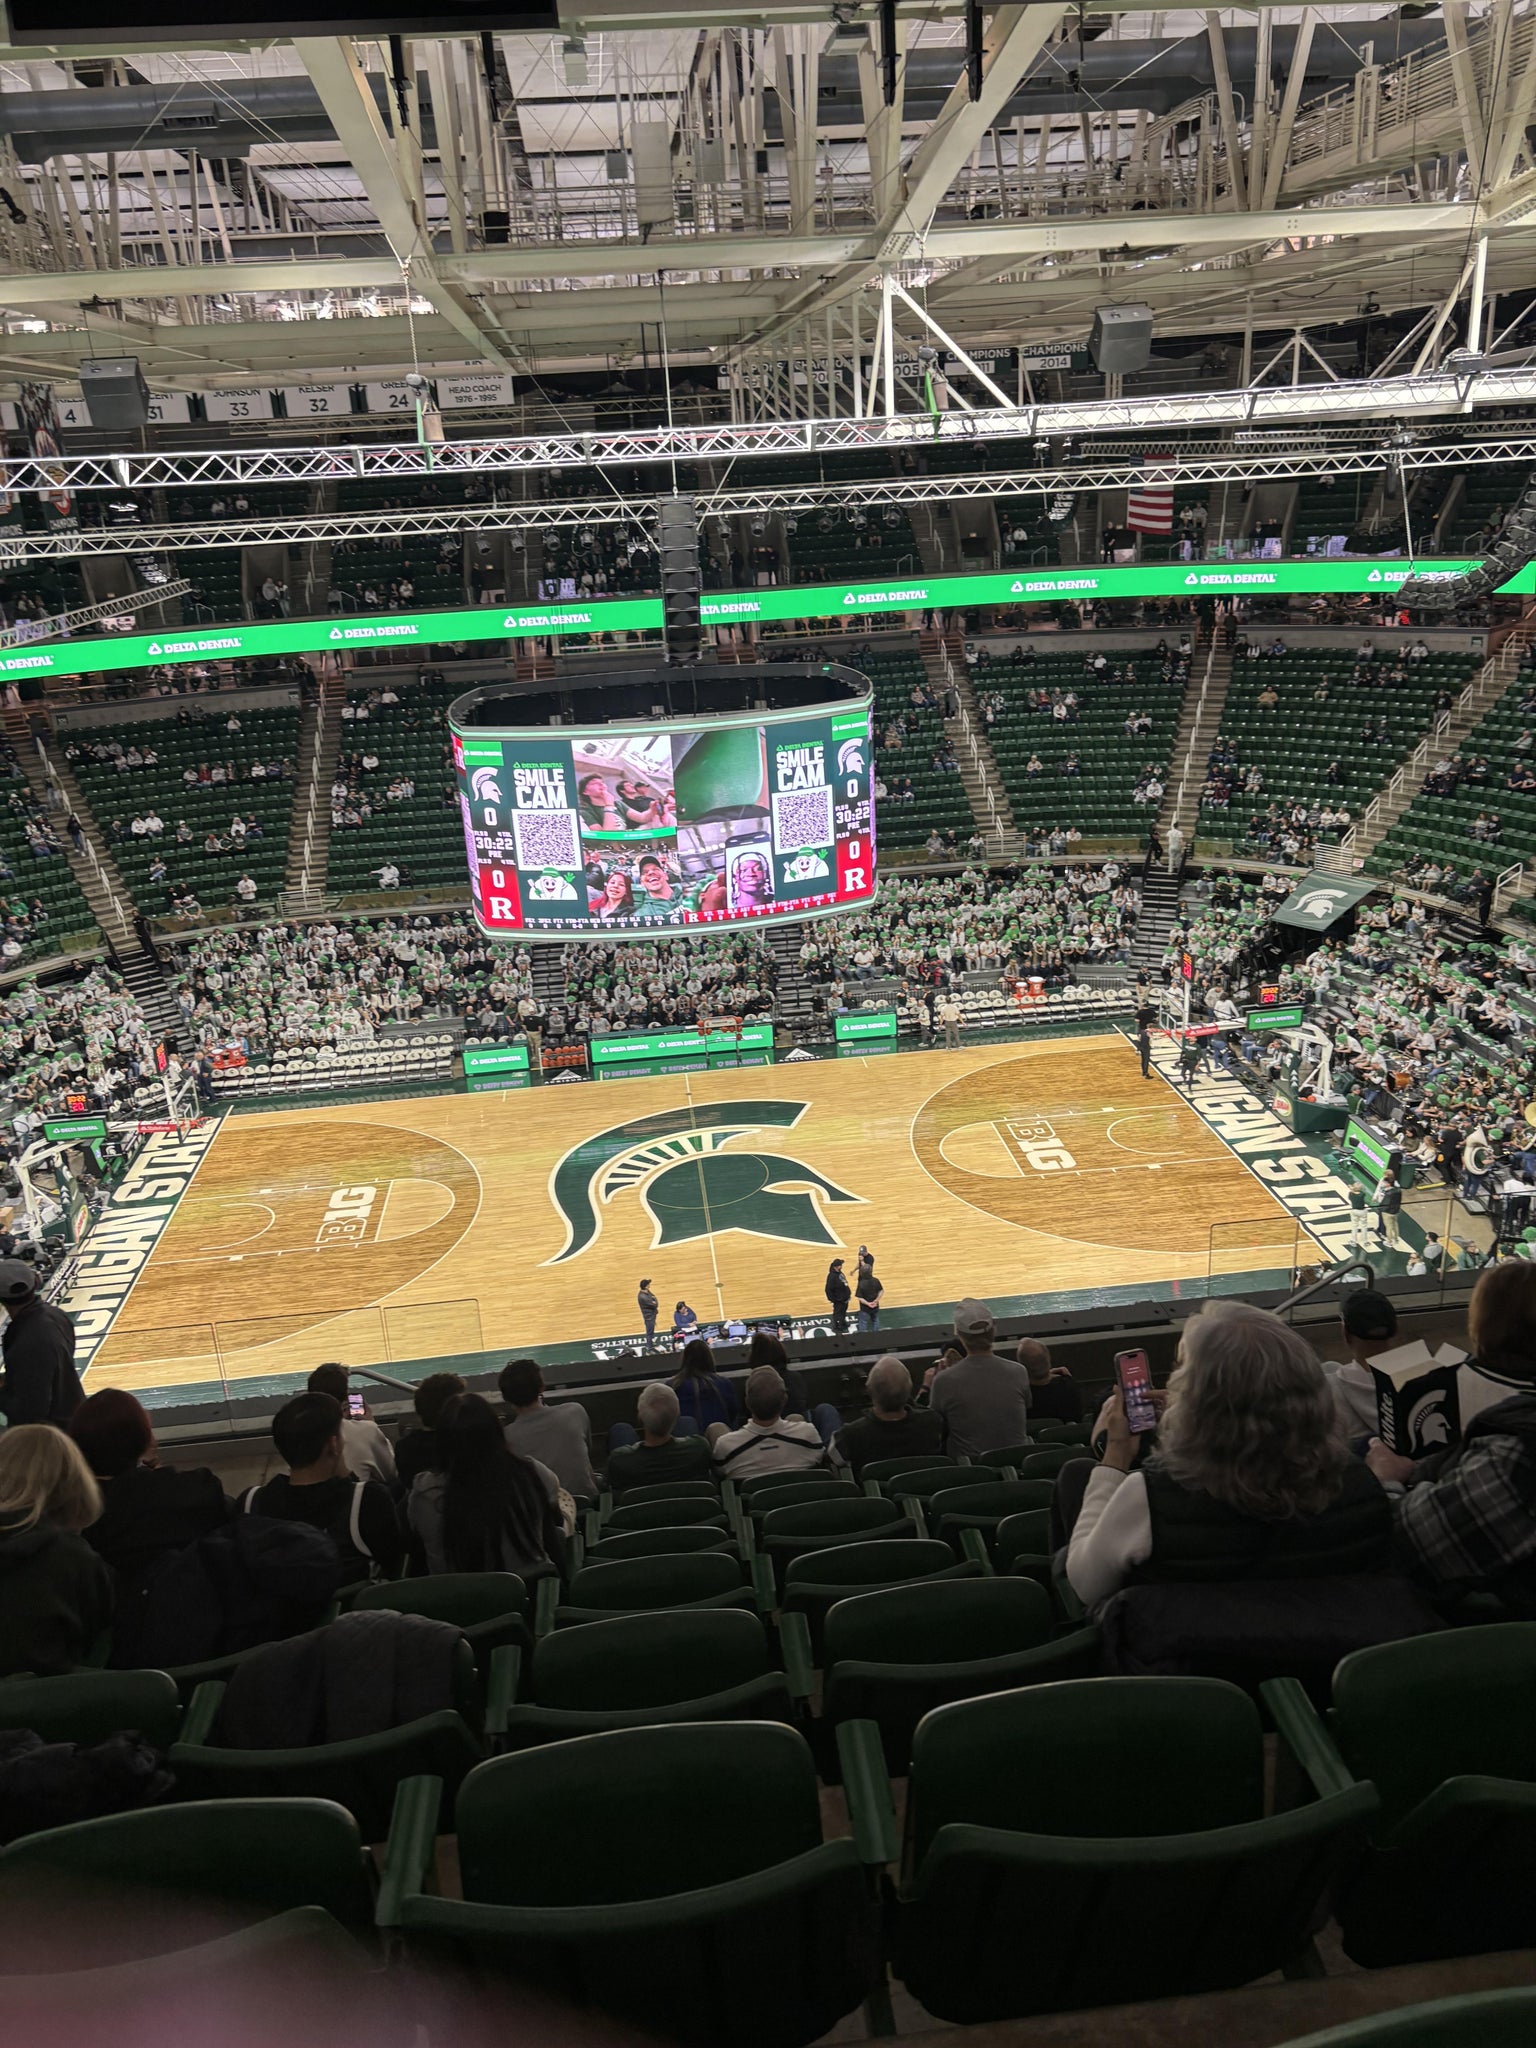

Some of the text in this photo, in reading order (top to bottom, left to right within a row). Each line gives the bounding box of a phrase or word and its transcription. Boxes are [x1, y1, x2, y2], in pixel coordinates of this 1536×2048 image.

[946, 349, 1011, 360] CMPIONS
[1023, 343, 1088, 356] CHAMPIONS
[1040, 357, 1067, 368] 2014
[309, 398, 329, 412] 32
[389, 394, 409, 408] 24
[65, 409, 76, 423] 4
[149, 405, 163, 419] 31
[230, 402, 249, 416] 33
[1026, 579, 1098, 592] DELTA DENTAL
[1201, 574, 1276, 585] DELTA DENTAL
[858, 590, 928, 603] DELTA DENTAL
[700, 603, 760, 615] ELTA DENTAL
[519, 613, 591, 627] DELTA DENTAL
[345, 625, 418, 638] DELTA DENTAL
[164, 638, 241, 654] DELTA DENTAL
[6, 656, 53, 669] DENTAL
[776, 746, 824, 769] SMILE
[513, 769, 565, 786] SMILE
[777, 763, 825, 791] CAM
[847, 779, 858, 798] 0
[516, 786, 568, 808] CAM
[484, 808, 497, 826] 0
[836, 807, 870, 823] 30:22
[847, 821, 860, 830] PRE
[476, 837, 513, 850] 30:22
[849, 841, 860, 860] 0
[488, 850, 502, 858] PRE
[492, 870, 505, 888] 0
[844, 867, 866, 892] R
[489, 897, 515, 919] R
[688, 913, 699, 923] R
[1263, 994, 1275, 1003] 20
[72, 1103, 84, 1111] 20
[58, 1204, 174, 1359] ICHIGAN
